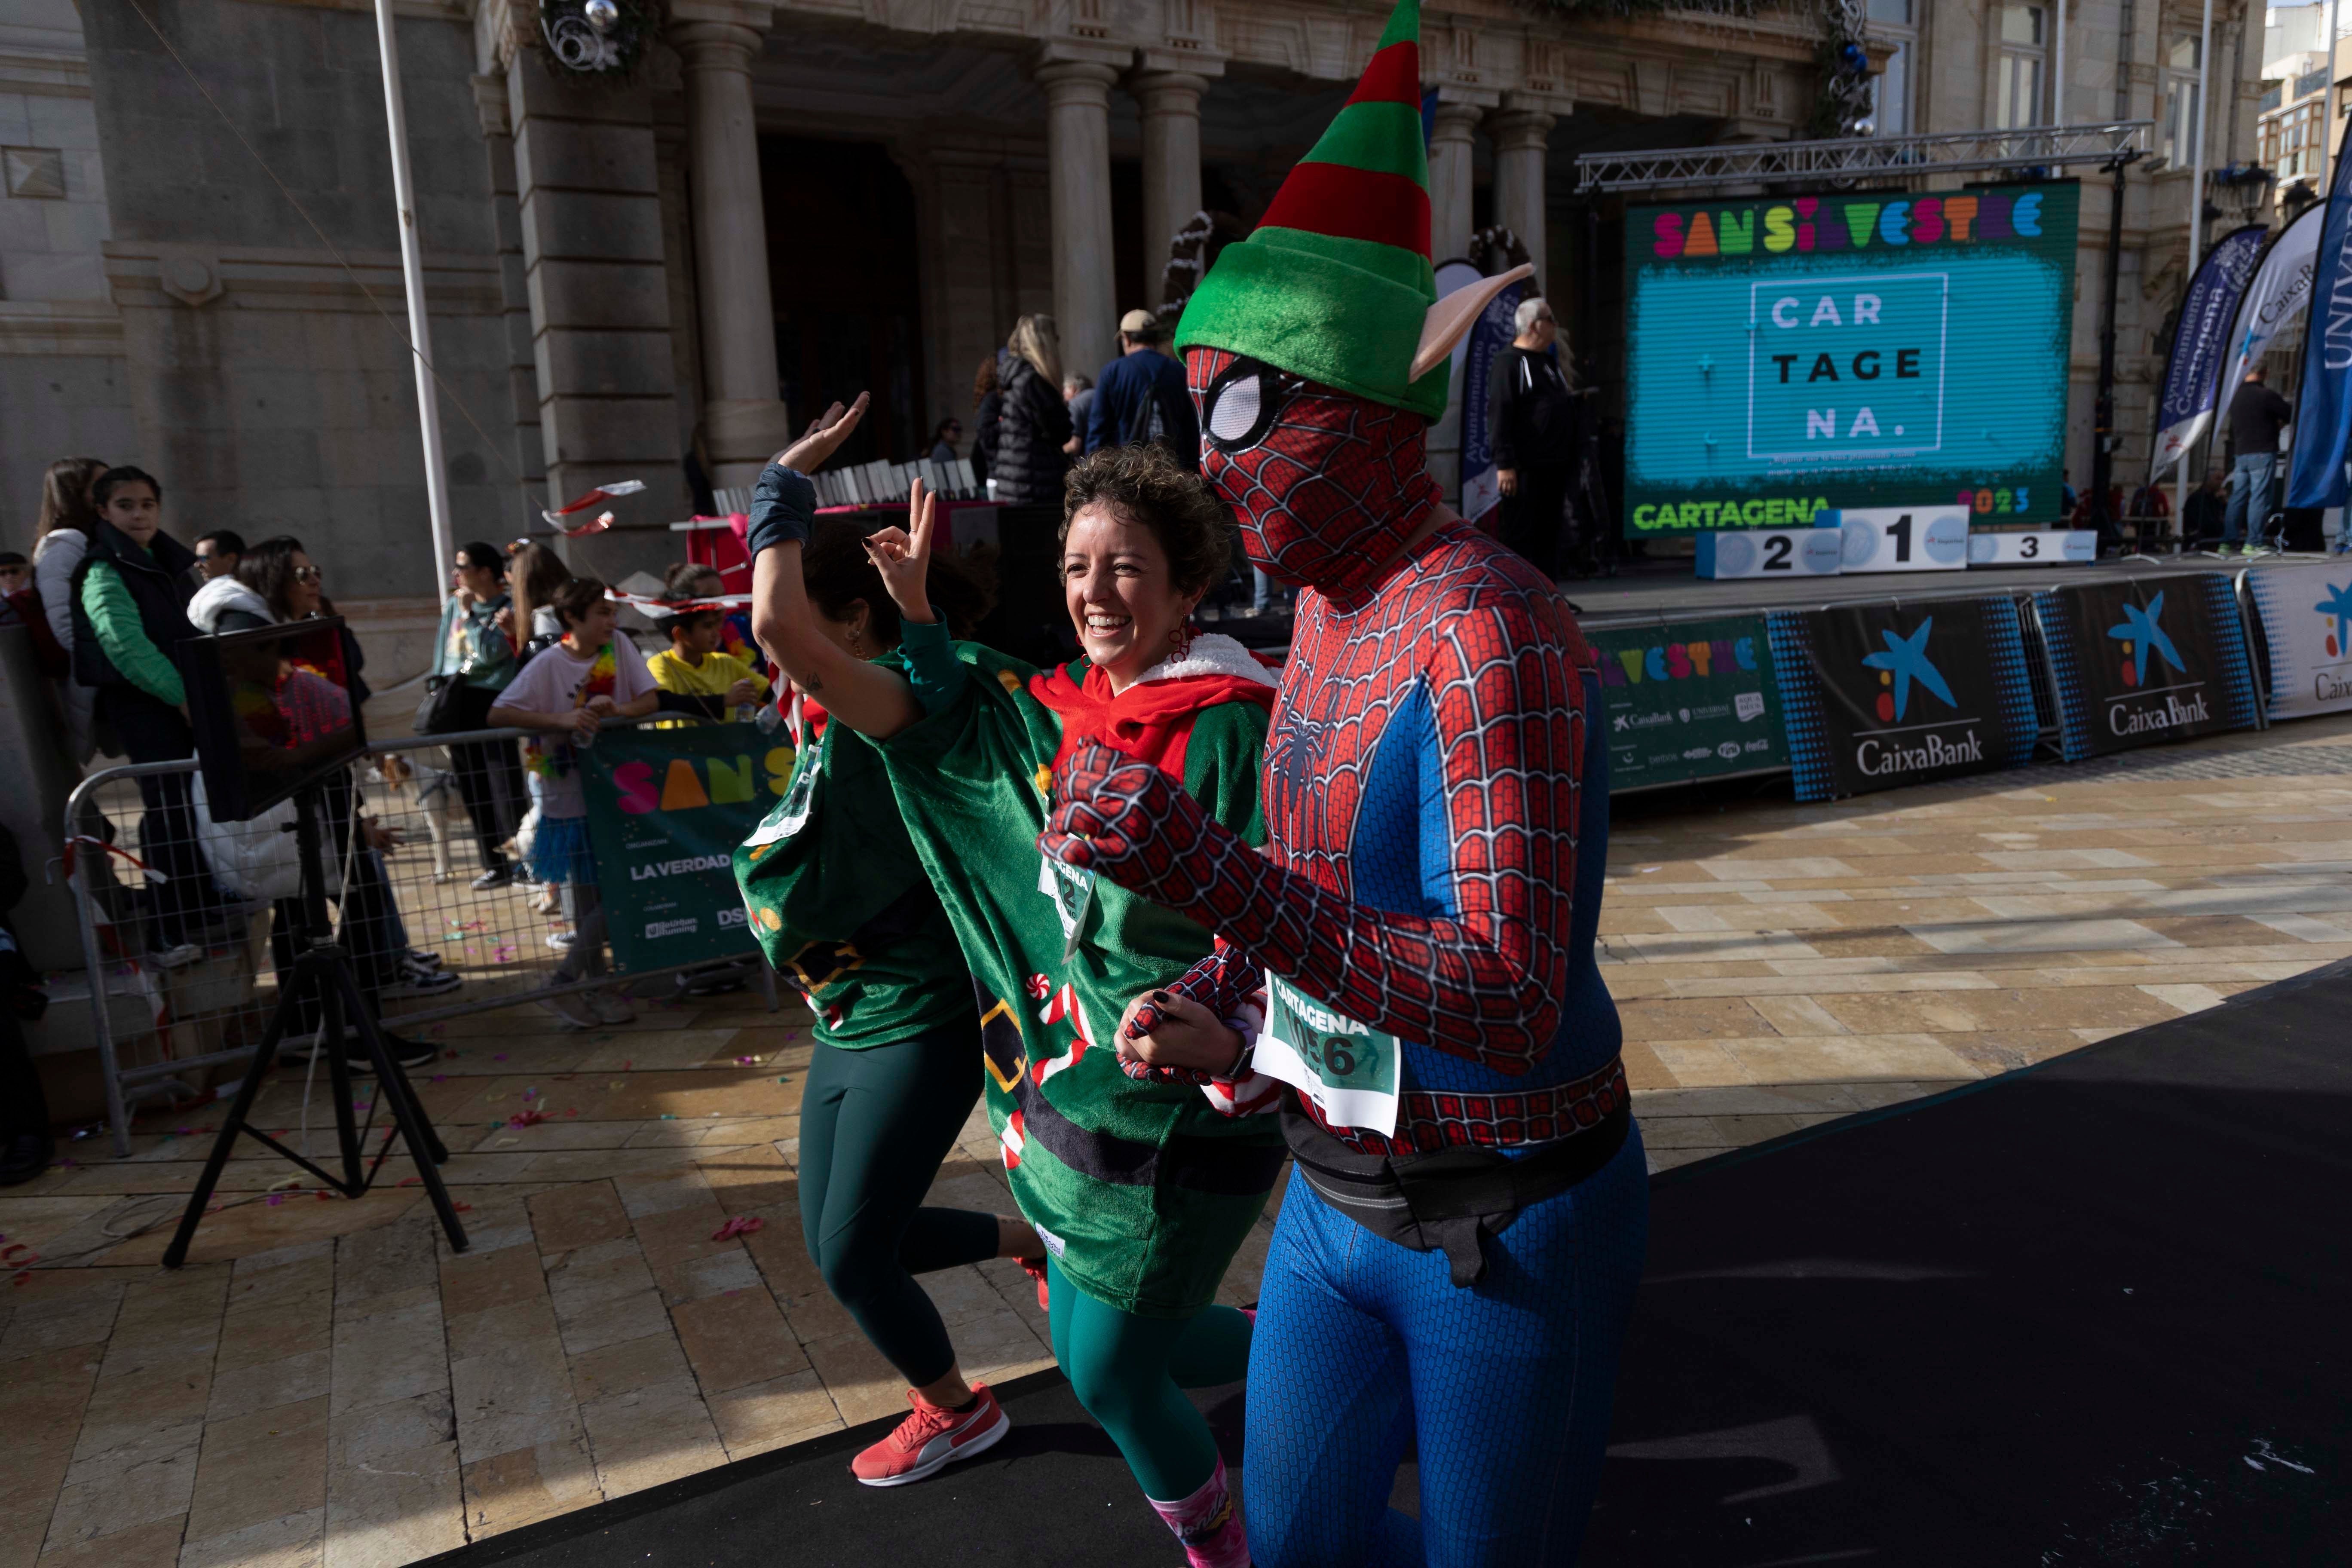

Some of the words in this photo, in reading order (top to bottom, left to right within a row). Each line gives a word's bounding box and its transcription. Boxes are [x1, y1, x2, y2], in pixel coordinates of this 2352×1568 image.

[1654, 211, 1755, 260] SAN
[1771, 294, 1883, 329] CAR
[1772, 348, 1922, 384] TAGE
[2162, 283, 2206, 413] Ayuntamiento
[2176, 287, 2225, 416] Cartagena
[1465, 340, 1485, 464] Ayuntamiento
[1806, 407, 1905, 440] NA.
[1633, 496, 1830, 530] CARTAGENA
[1763, 535, 1793, 571] 2
[1886, 514, 1912, 563] 1
[2020, 536, 2039, 558] 3
[2315, 672, 2352, 702] Caix
[1629, 710, 1674, 726] CaixaBank
[2109, 691, 2210, 737] CaixaBank
[1856, 728, 1983, 776] CaixaBank
[613, 754, 755, 815] SAN
[630, 864, 657, 881] LA
[656, 854, 732, 876] VERDAD
[1275, 977, 1370, 1037] CARTAGENA
